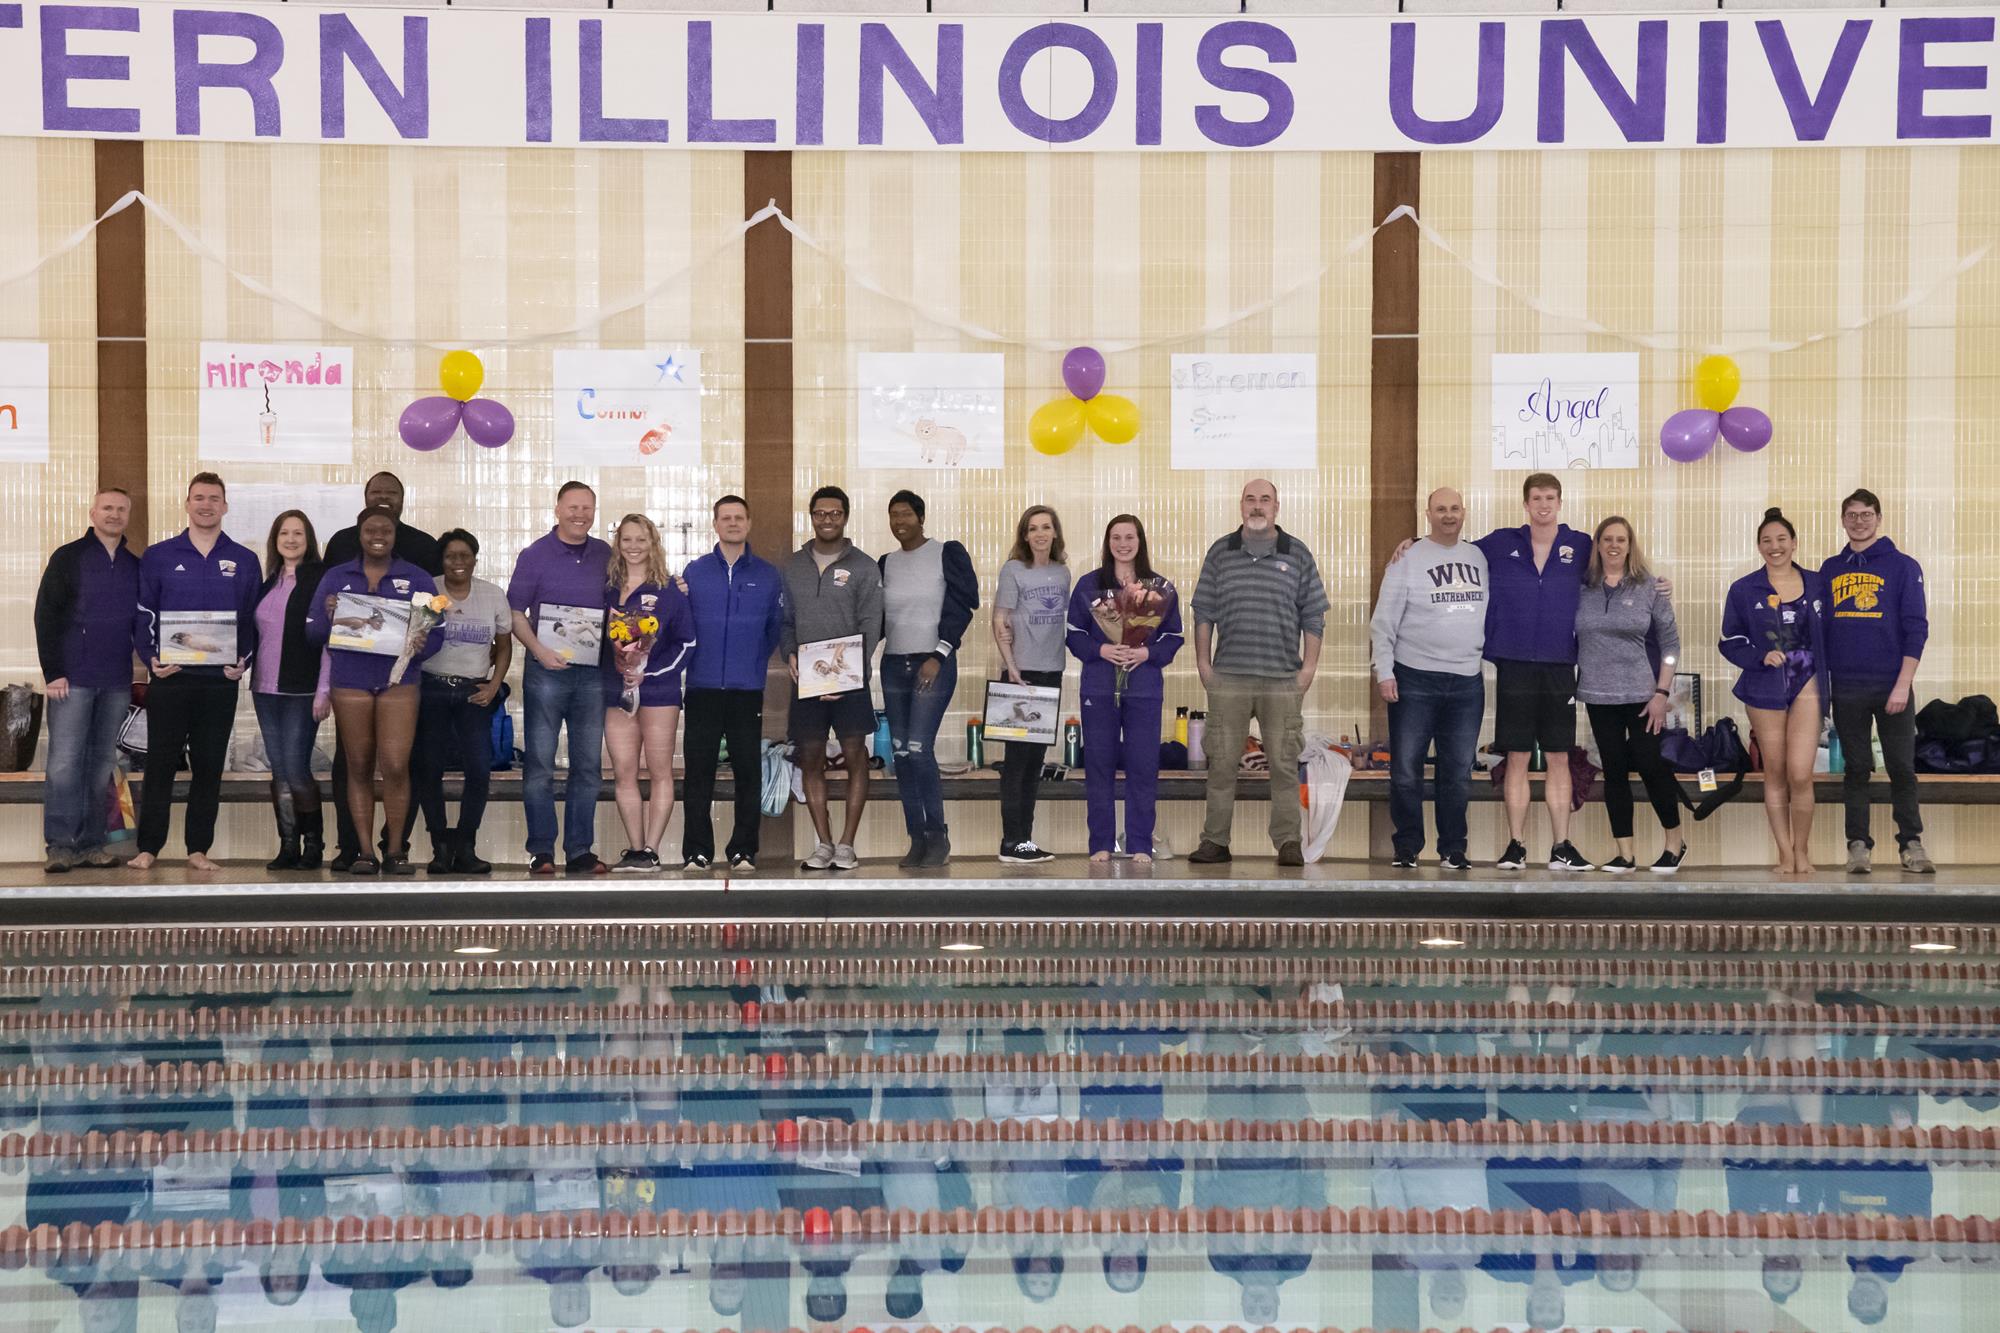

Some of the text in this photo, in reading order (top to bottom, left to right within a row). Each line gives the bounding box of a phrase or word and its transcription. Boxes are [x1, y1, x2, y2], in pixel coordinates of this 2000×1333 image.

[0, 4, 1995, 147] ERN ILLINOIS UNIVE
[1518, 377, 1609, 437] Angel
[1427, 562, 1481, 588] WIU
[1831, 572, 1885, 594] WESTERN
[1833, 583, 1880, 608] ILLINOIS
